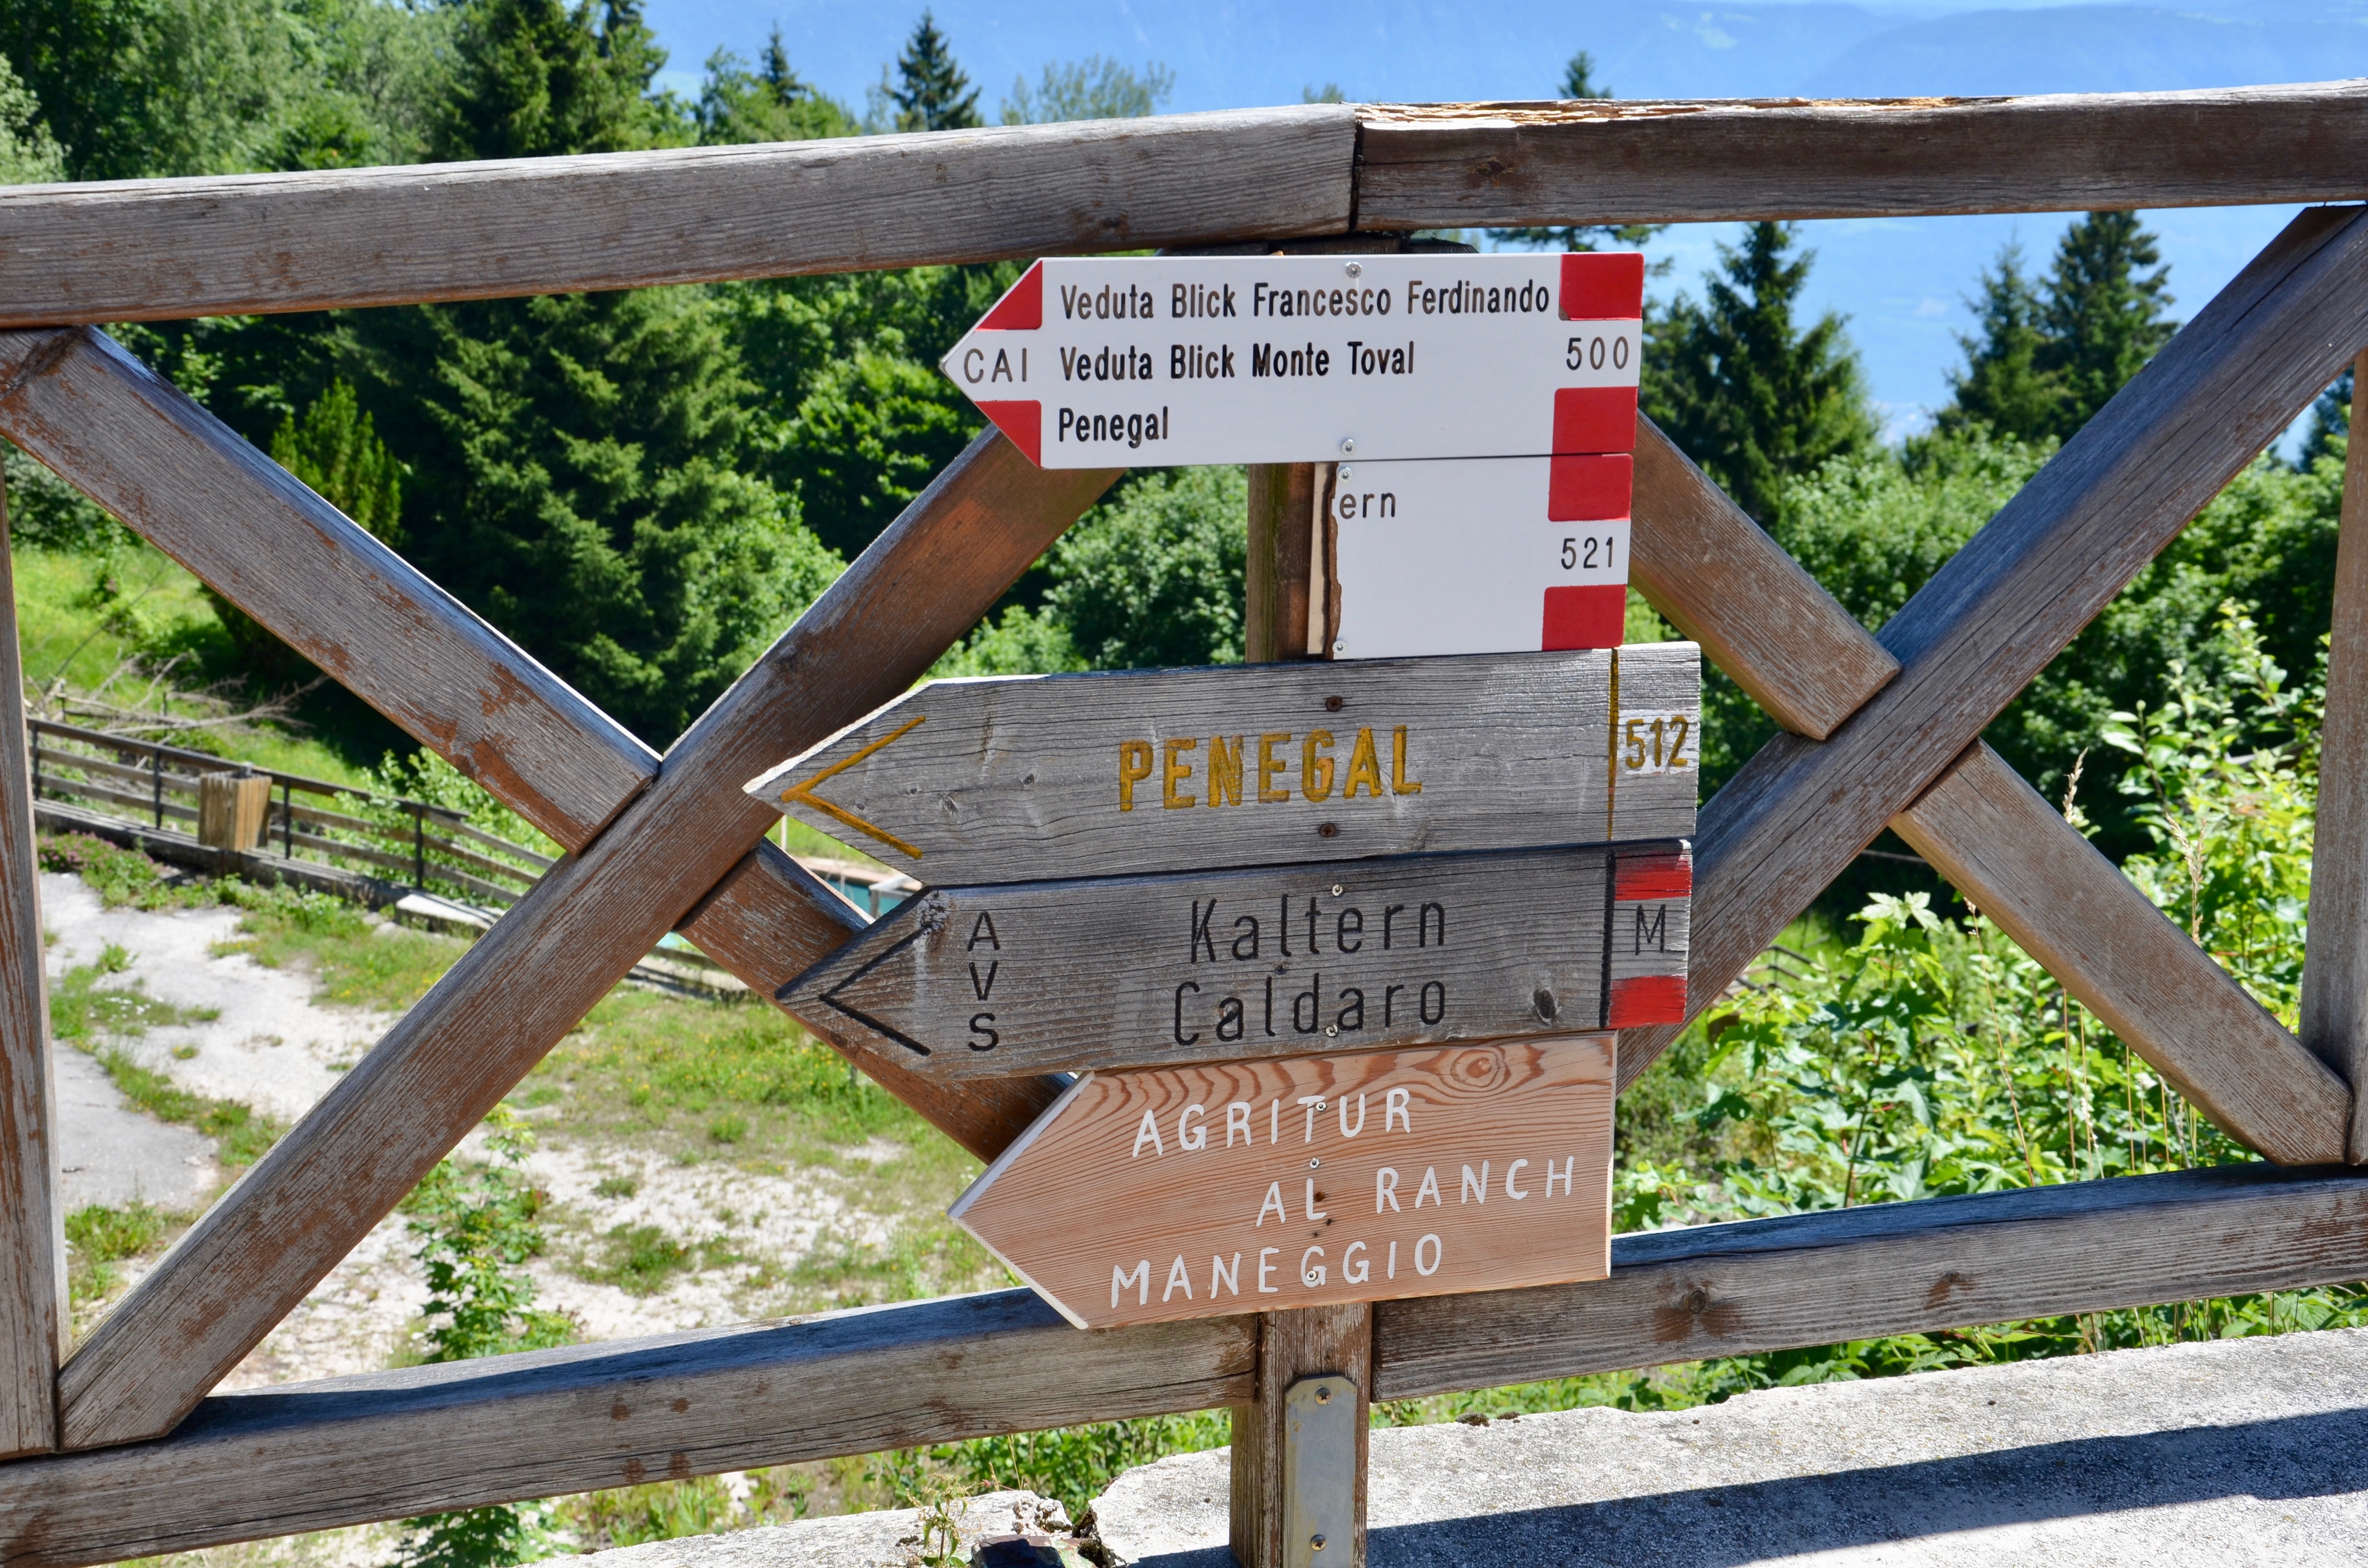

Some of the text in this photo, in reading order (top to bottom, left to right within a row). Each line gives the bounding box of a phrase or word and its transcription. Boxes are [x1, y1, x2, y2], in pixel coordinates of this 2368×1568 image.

[1061, 279, 1549, 319] Veduta Blick Francesco Ferdinando
[964, 348, 1027, 383] CAI
[1060, 341, 1414, 381] Veduta Blick Monte Toval
[1566, 336, 1628, 370] 500
[1059, 406, 1168, 448] Penegal
[1561, 537, 1613, 570] 521
[1120, 724, 1422, 811] PENEGAL
[1626, 715, 1689, 768] 512
[1191, 894, 1444, 963] Kaltern
[1635, 904, 1666, 956] M
[1174, 972, 1445, 1045] Caldaro
[1133, 1088, 1411, 1157] AGRITUR
[1256, 1156, 1574, 1227] AL RANCH
[1111, 1234, 1442, 1309] MANEGGIO
